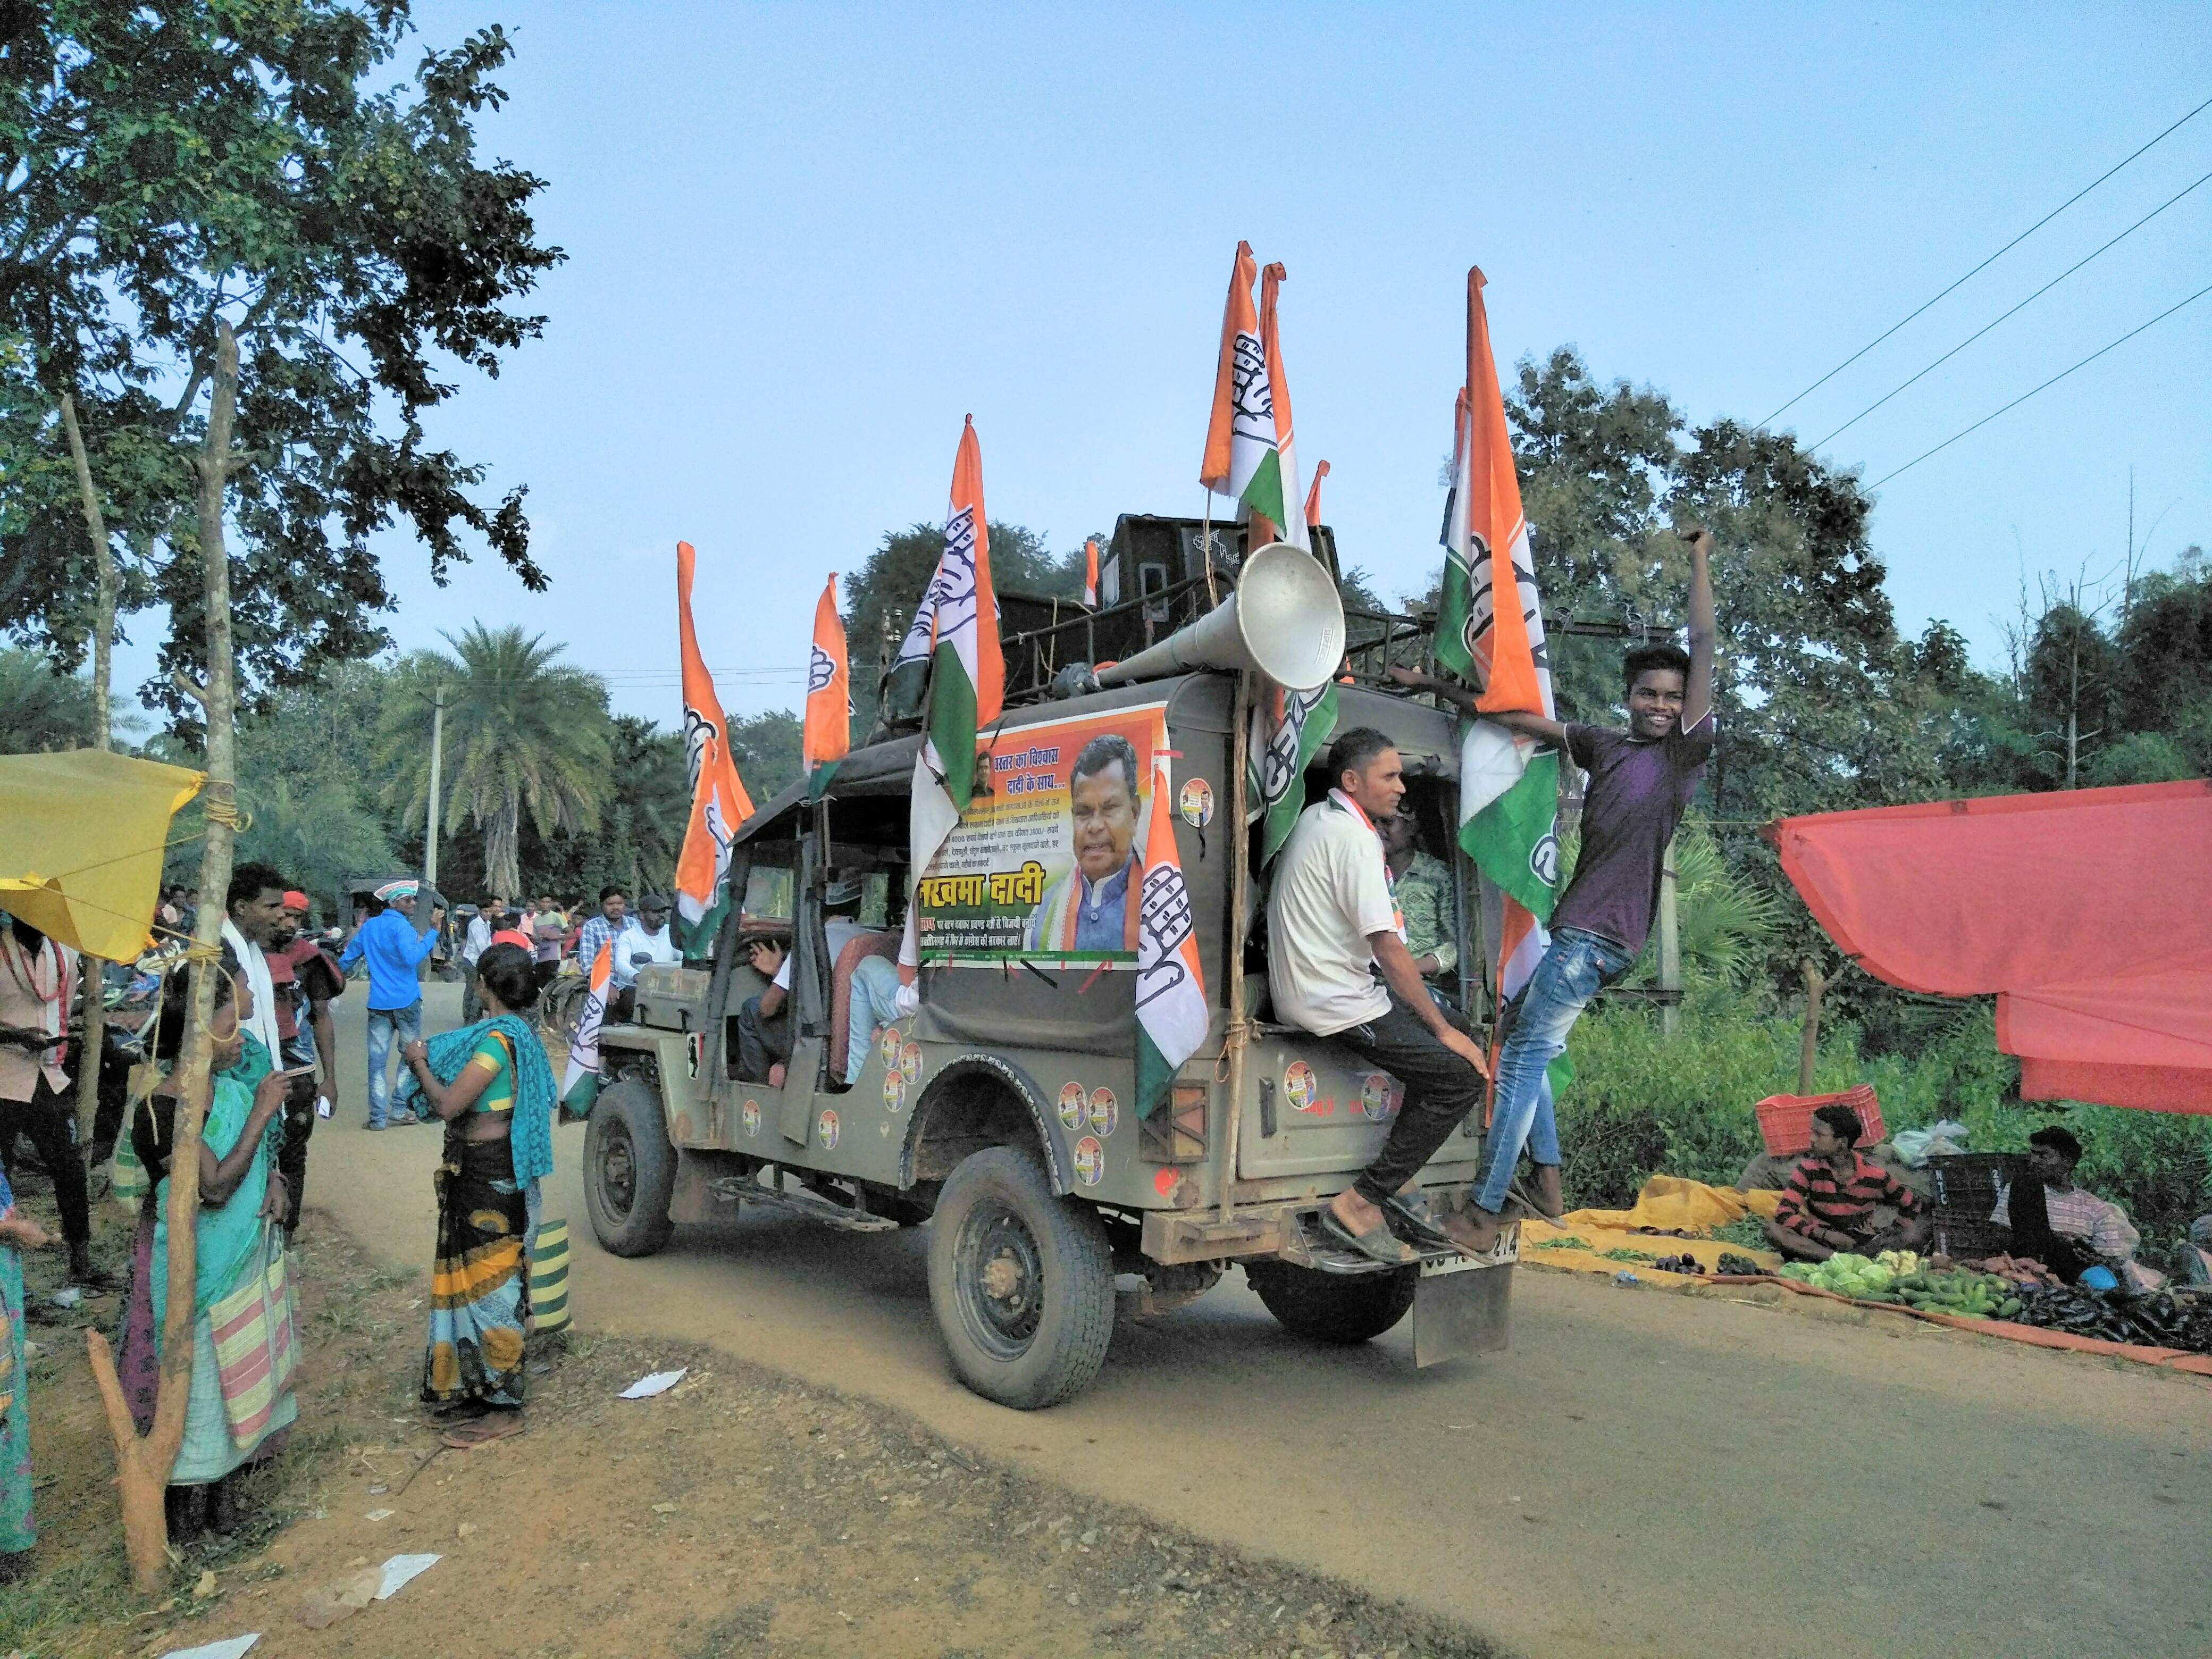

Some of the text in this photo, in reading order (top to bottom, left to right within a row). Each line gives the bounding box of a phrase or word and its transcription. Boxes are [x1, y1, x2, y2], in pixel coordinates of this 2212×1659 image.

[1015, 752, 1028, 768] का
[1029, 747, 1060, 767] विश्वास
[1007, 774, 1024, 795] दादी
[1026, 772, 1035, 792] के
[989, 860, 1046, 906] दादी
[936, 920, 944, 930] पर
[1002, 916, 1021, 929] विजयी
[964, 933, 979, 946] कांग्रेस
[980, 933, 987, 946] की
[988, 936, 1006, 946] सरकार
